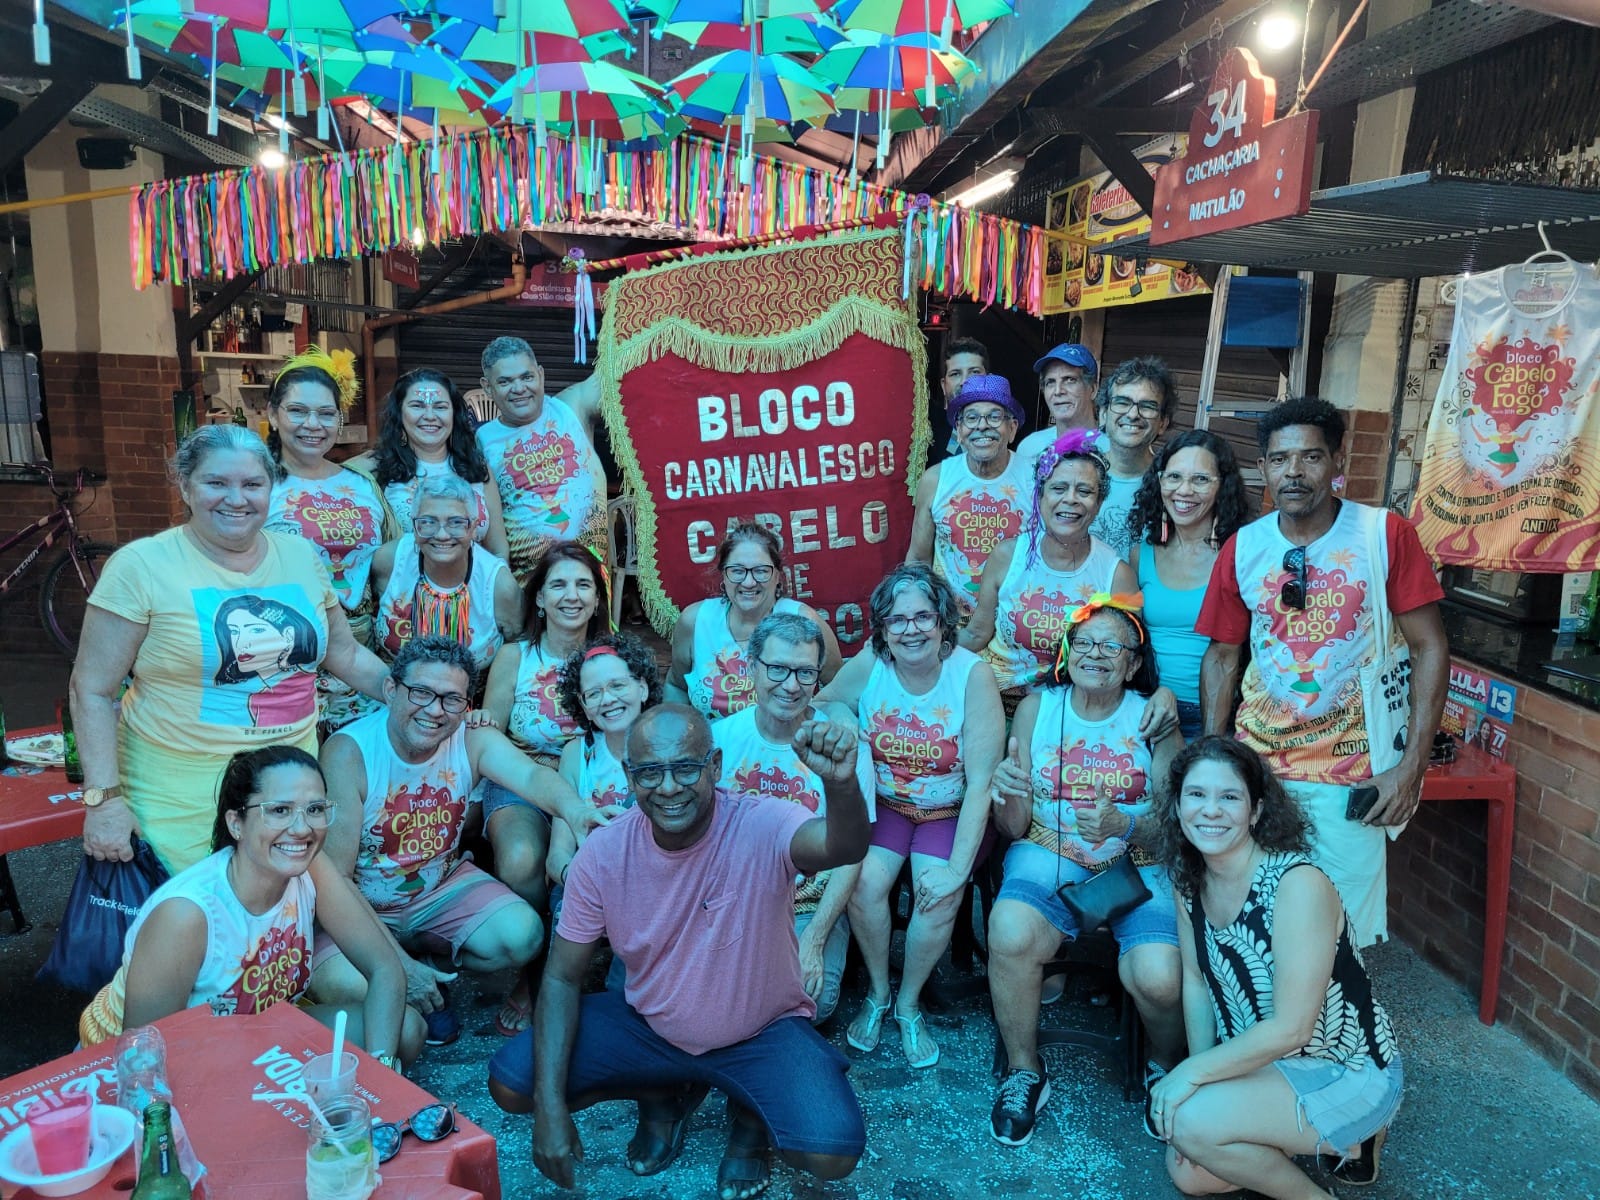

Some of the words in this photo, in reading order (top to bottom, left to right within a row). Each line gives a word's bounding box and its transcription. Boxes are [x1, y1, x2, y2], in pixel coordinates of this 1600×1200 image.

[1203, 79, 1247, 148] 34
[1185, 140, 1260, 185] CACHAÇARIA
[1189, 188, 1246, 221] MATULÃO
[1506, 351, 1542, 364] bloco
[1484, 362, 1556, 384] Cabelo
[1492, 383, 1543, 415] Fogo
[1517, 381, 1536, 395] de
[697, 381, 856, 443] BLOCO
[511, 443, 564, 472] Cabelo
[524, 464, 565, 487] Fogo
[664, 439, 895, 500] CARNAVALESCO
[302, 507, 362, 522] Cabelo
[971, 502, 998, 514] bloco
[337, 519, 353, 530] de
[955, 511, 1009, 529] Cabelo
[316, 520, 364, 546] Fogo
[981, 527, 995, 538] de
[1022, 609, 1067, 631] Cabe
[1307, 608, 1326, 621] de
[1286, 611, 1336, 643] Fogo
[720, 673, 754, 693] Cab
[1449, 668, 1486, 697] LULA
[1491, 686, 1514, 714] 13
[896, 723, 928, 740] bloco
[874, 732, 943, 759] Cabelo
[1083, 754, 1117, 769] bloco
[760, 778, 789, 793] bloco
[391, 805, 452, 835] Cabelo
[421, 826, 437, 840] de
[398, 829, 444, 860] Fogo
